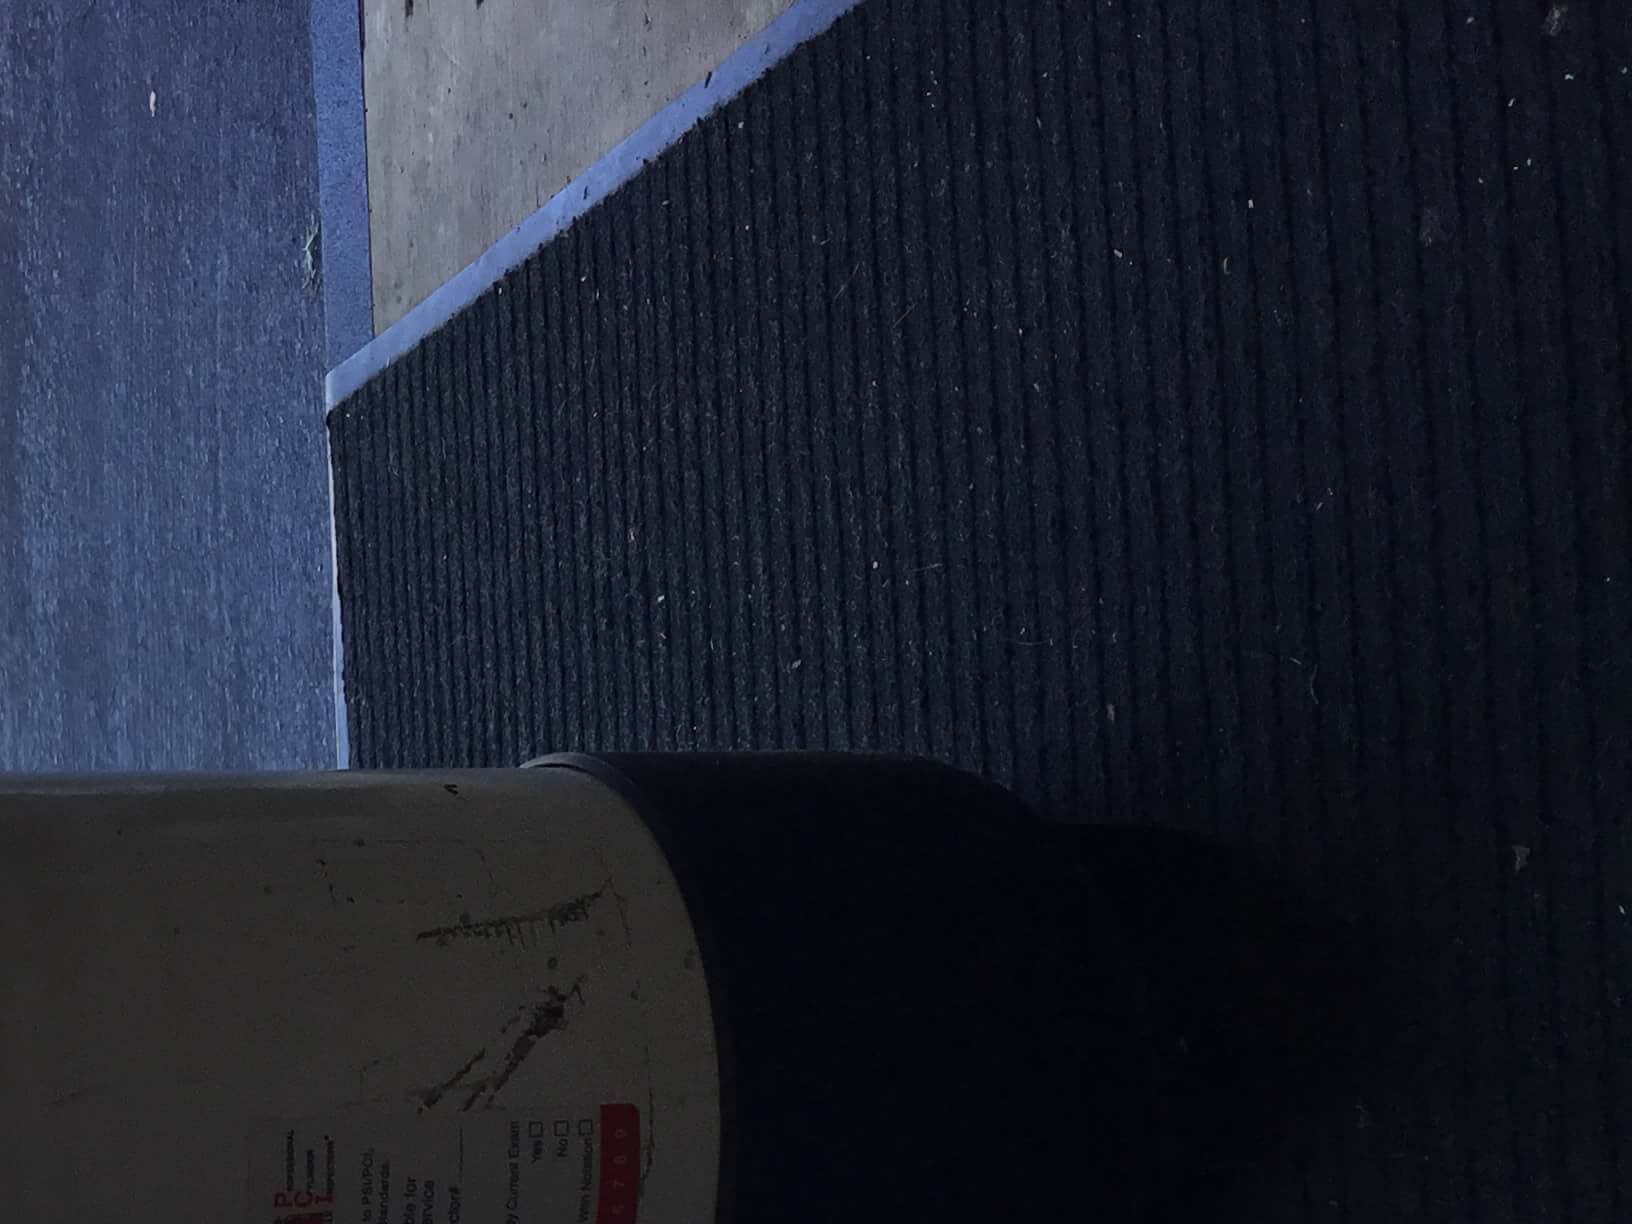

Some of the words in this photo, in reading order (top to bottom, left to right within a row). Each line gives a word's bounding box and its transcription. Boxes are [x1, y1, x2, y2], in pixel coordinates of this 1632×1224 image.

[508, 1120, 520, 1158] Exam
[529, 1139, 543, 1164] Yes
[556, 1138, 568, 1157] No
[403, 1177, 417, 1199] for
[505, 1162, 519, 1210] Current
